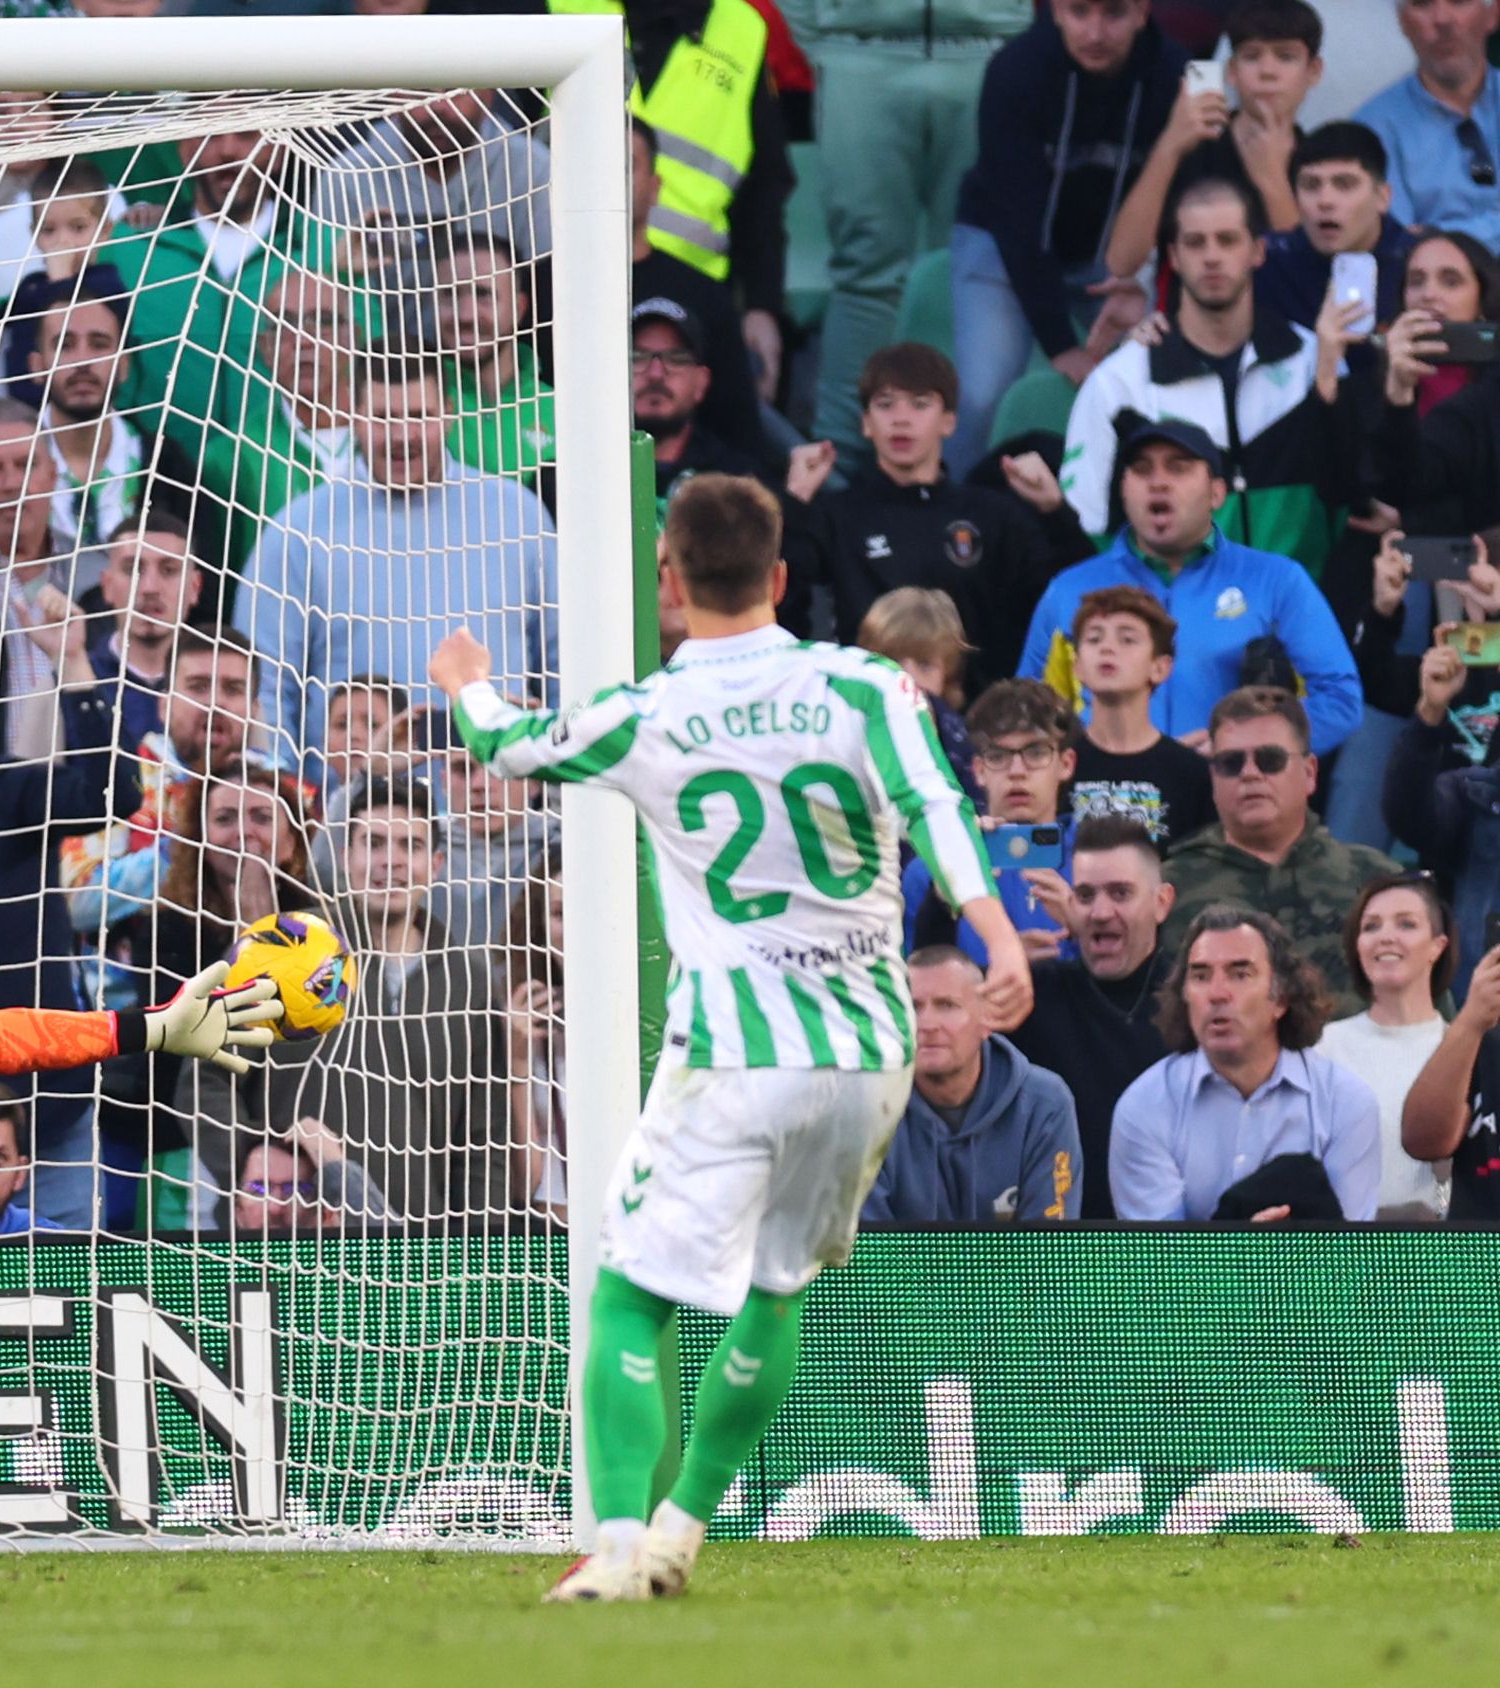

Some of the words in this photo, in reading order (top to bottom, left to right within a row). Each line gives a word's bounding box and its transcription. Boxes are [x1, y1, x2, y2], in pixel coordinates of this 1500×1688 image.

[666, 715, 711, 754] LO
[723, 701, 832, 738] CELSO
[677, 762, 882, 924] 20
